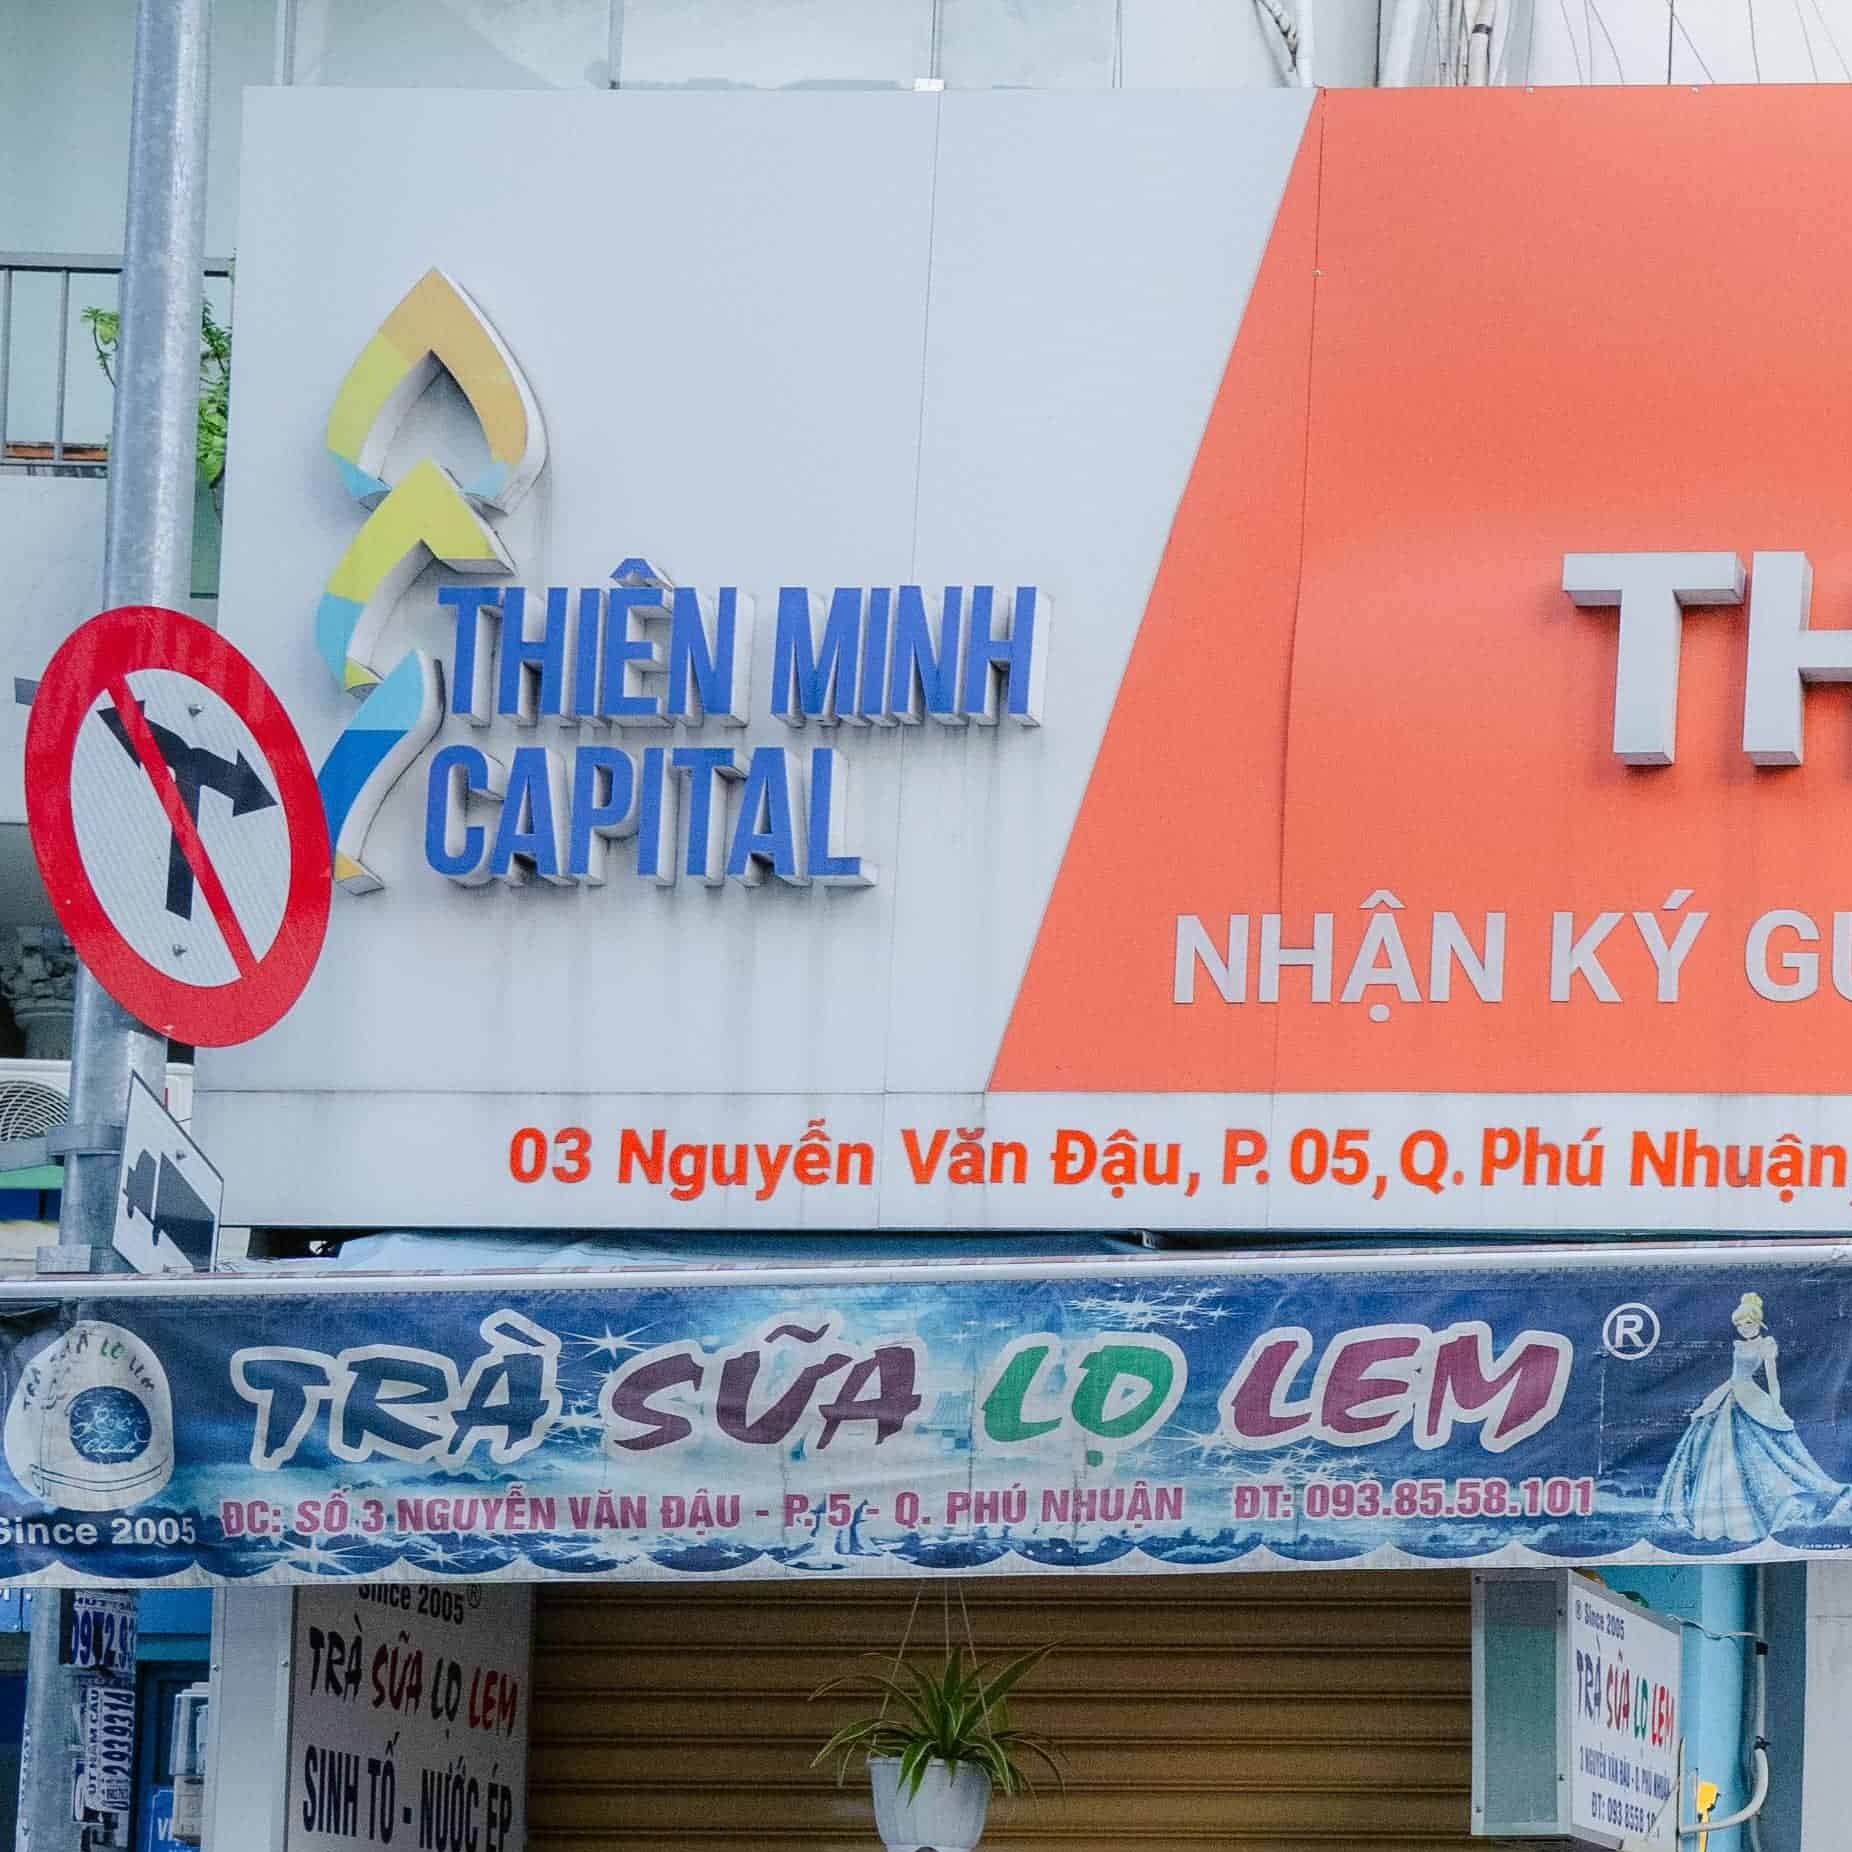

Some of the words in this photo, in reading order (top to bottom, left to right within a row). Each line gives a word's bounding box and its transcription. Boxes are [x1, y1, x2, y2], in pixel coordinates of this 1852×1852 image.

[437, 557, 748, 726] THIÊN
[770, 585, 1044, 726] MINH
[424, 744, 872, 888] CAPITAL
[1173, 889, 1505, 1023] NHẬN
[1550, 888, 1708, 1005] KÝ
[510, 1127, 591, 1183] 03
[618, 1119, 872, 1201] Nguyễn
[902, 1127, 1026, 1184] Văn
[1050, 1129, 1198, 1197] Đậu,
[1223, 1129, 1268, 1184] P.
[1290, 1128, 1385, 1198] 05,
[1400, 1129, 1462, 1192] Q.
[1481, 1127, 1603, 1185] Phú
[234, 1311, 560, 1467] TRÀ
[611, 1321, 924, 1452] SỮA
[981, 1342, 1176, 1468] LỌ
[1228, 1333, 1564, 1442] LEM
[110, 1515, 197, 1546] 2005
[221, 1498, 282, 1538] ĐC:
[295, 1487, 350, 1534] SỐ
[360, 1498, 386, 1535] 3
[397, 1481, 561, 1534] NGUYỄN
[567, 1488, 656, 1530] VĂN
[659, 1488, 741, 1538] ĐẬU
[827, 1492, 853, 1528] 5
[894, 1492, 931, 1528] Q.
[946, 1481, 1028, 1525] PHÚ
[1040, 1483, 1185, 1530] NHUẬN
[1233, 1485, 1294, 1522] ĐT:
[1305, 1477, 1595, 1519] 093.85.58.101
[417, 1584, 465, 1625] 2005
[309, 1611, 363, 1703] TRÀ
[370, 1629, 423, 1716] SỮA
[430, 1656, 462, 1741] LỌ
[467, 1665, 518, 1737] LEM
[302, 1744, 360, 1837] SINH
[367, 1731, 400, 1846] TỐ
